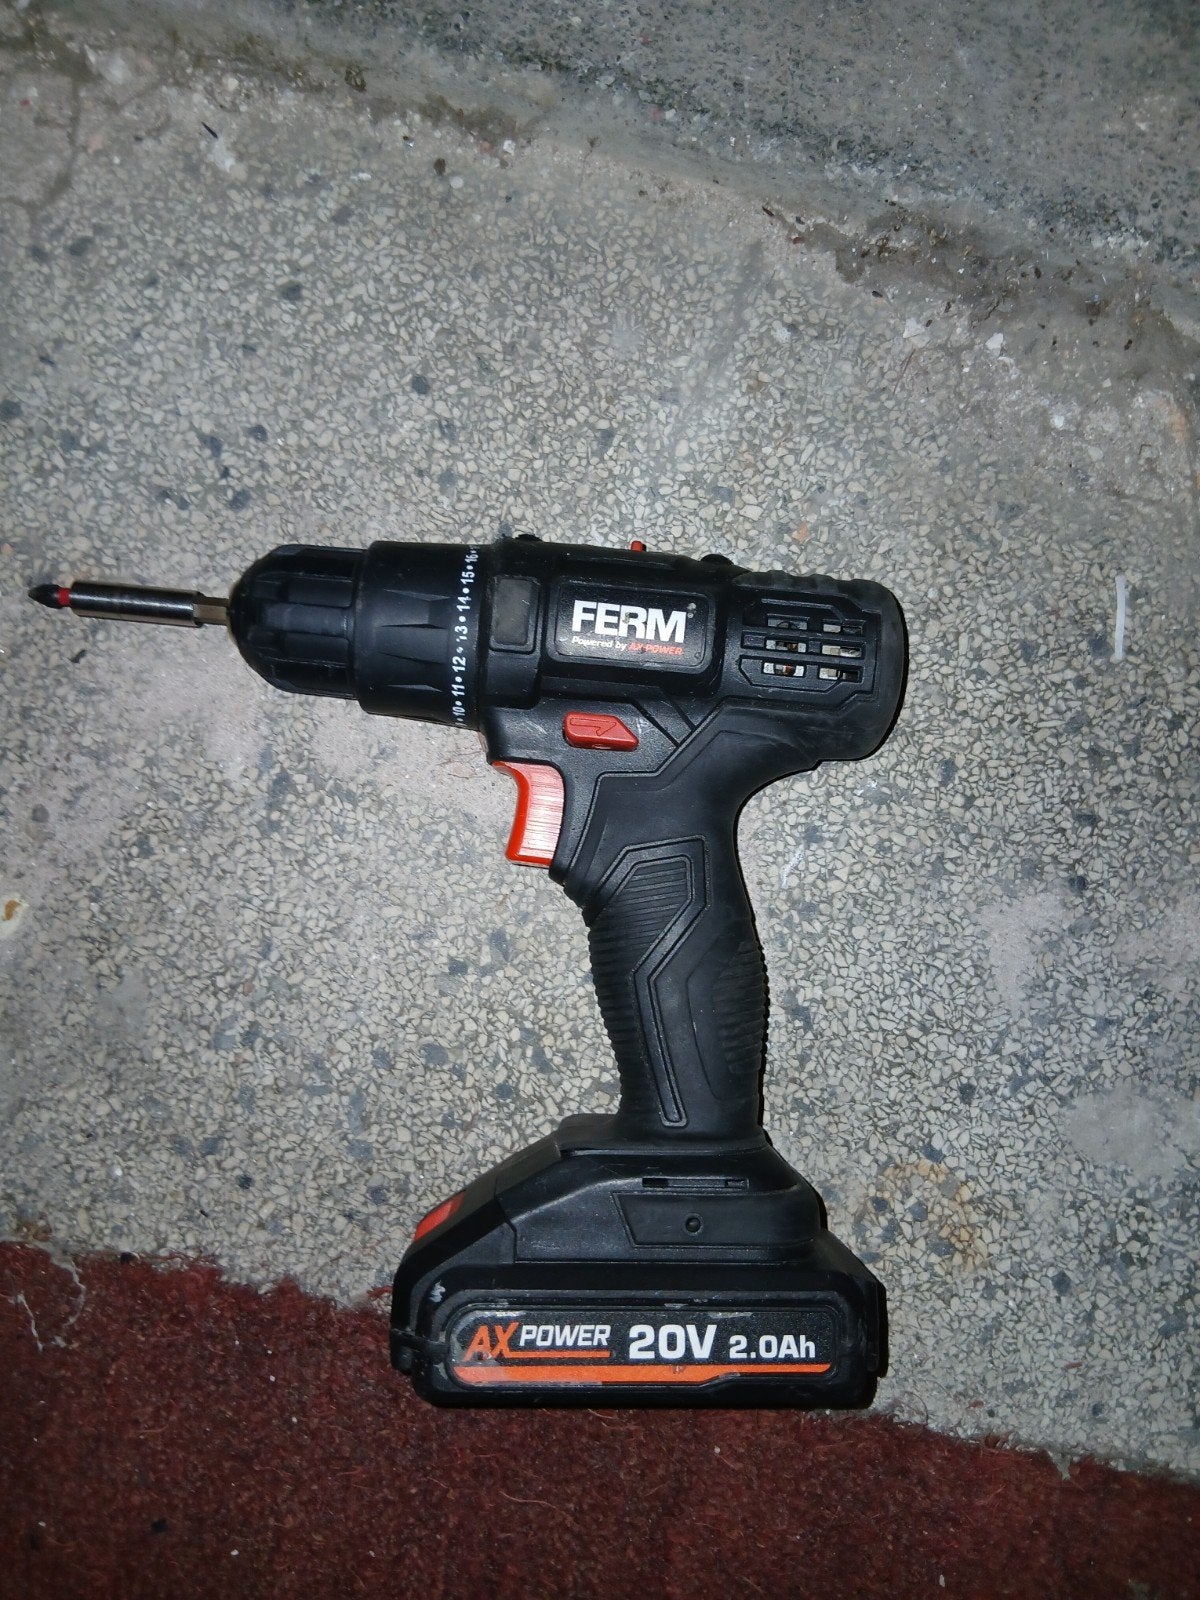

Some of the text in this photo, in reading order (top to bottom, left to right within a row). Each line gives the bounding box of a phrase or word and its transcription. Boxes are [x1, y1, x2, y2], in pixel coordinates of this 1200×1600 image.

[464, 554, 479, 563] 16
[460, 571, 476, 585] 15
[456, 595, 472, 612] 14
[572, 599, 687, 643] FERM
[571, 635, 613, 648] Powered
[615, 641, 628, 651] by
[452, 656, 466, 673] 12
[451, 684, 465, 697] 11
[452, 706, 466, 717] 10
[629, 1324, 717, 1360] 20V
[729, 1334, 816, 1359] 2.0Ah
